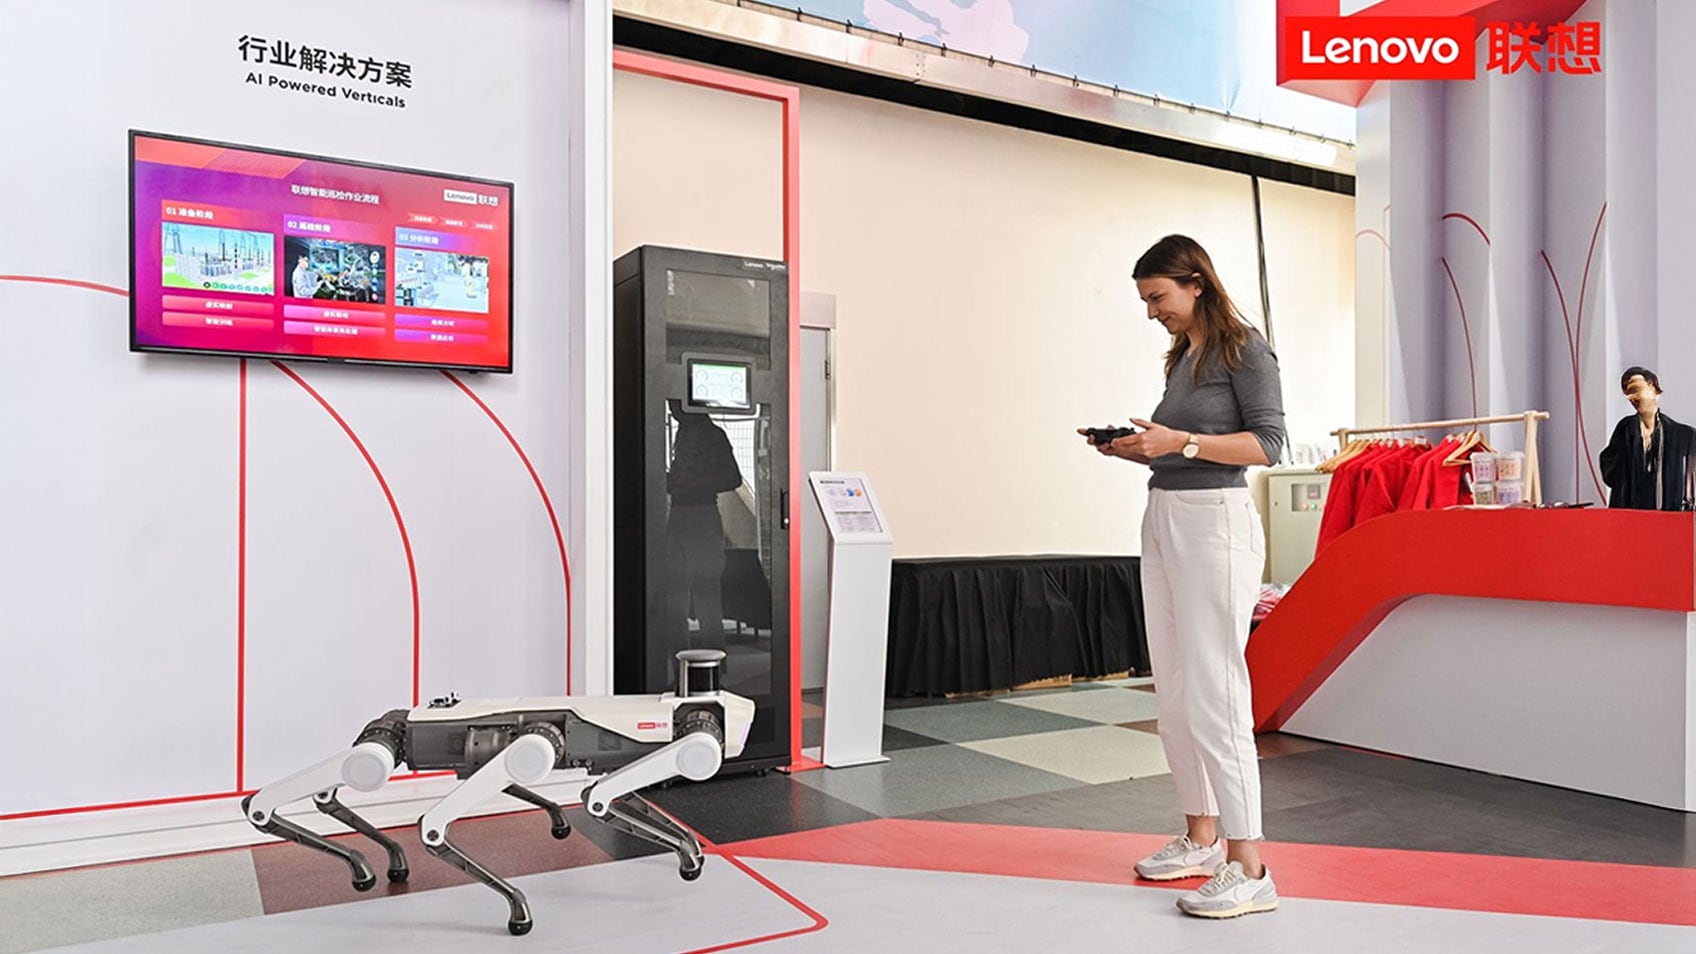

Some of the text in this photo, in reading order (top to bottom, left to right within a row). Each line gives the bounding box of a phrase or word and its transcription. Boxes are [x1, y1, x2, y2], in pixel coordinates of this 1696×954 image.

[238, 35, 412, 89] 行业解决方案
[245, 72, 406, 108] AI Powered Verticals
[446, 191, 475, 202] Lenovo
[166, 206, 176, 216] 01
